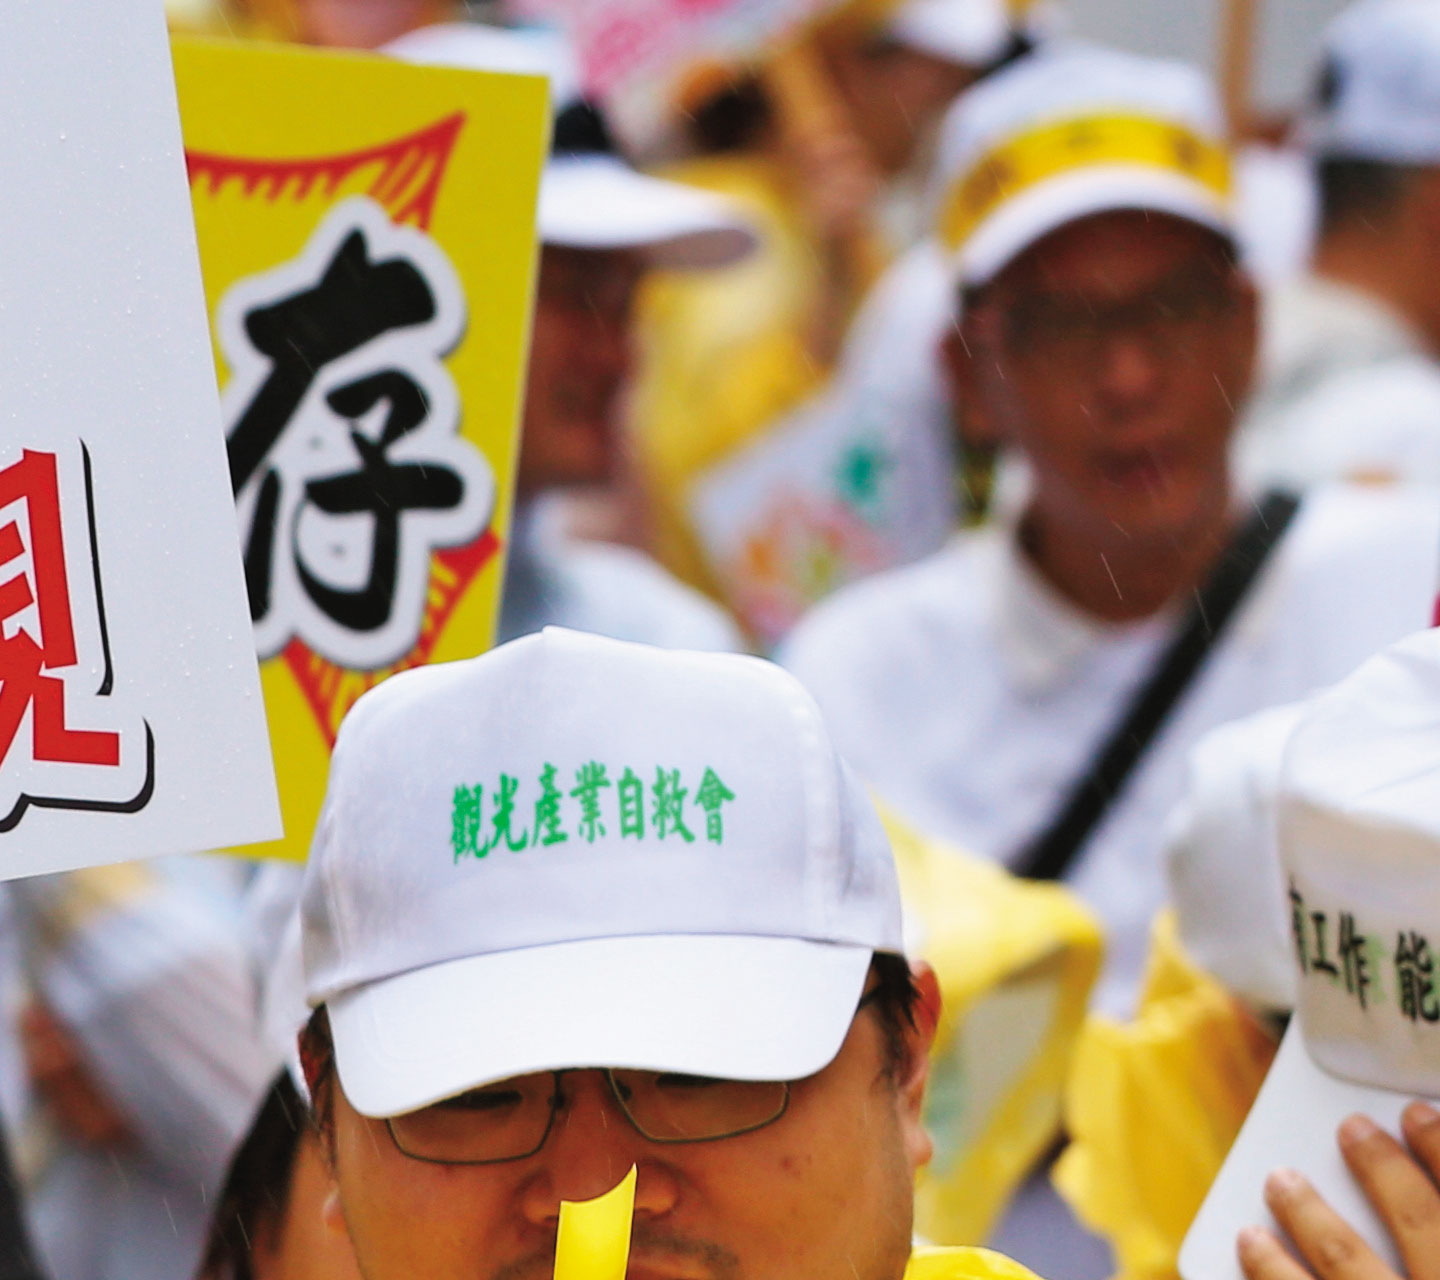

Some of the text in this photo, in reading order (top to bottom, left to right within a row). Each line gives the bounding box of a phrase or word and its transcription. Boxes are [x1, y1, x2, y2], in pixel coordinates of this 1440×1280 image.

[226, 228, 465, 633] 存
[450, 760, 736, 864] 觀光產業自救會
